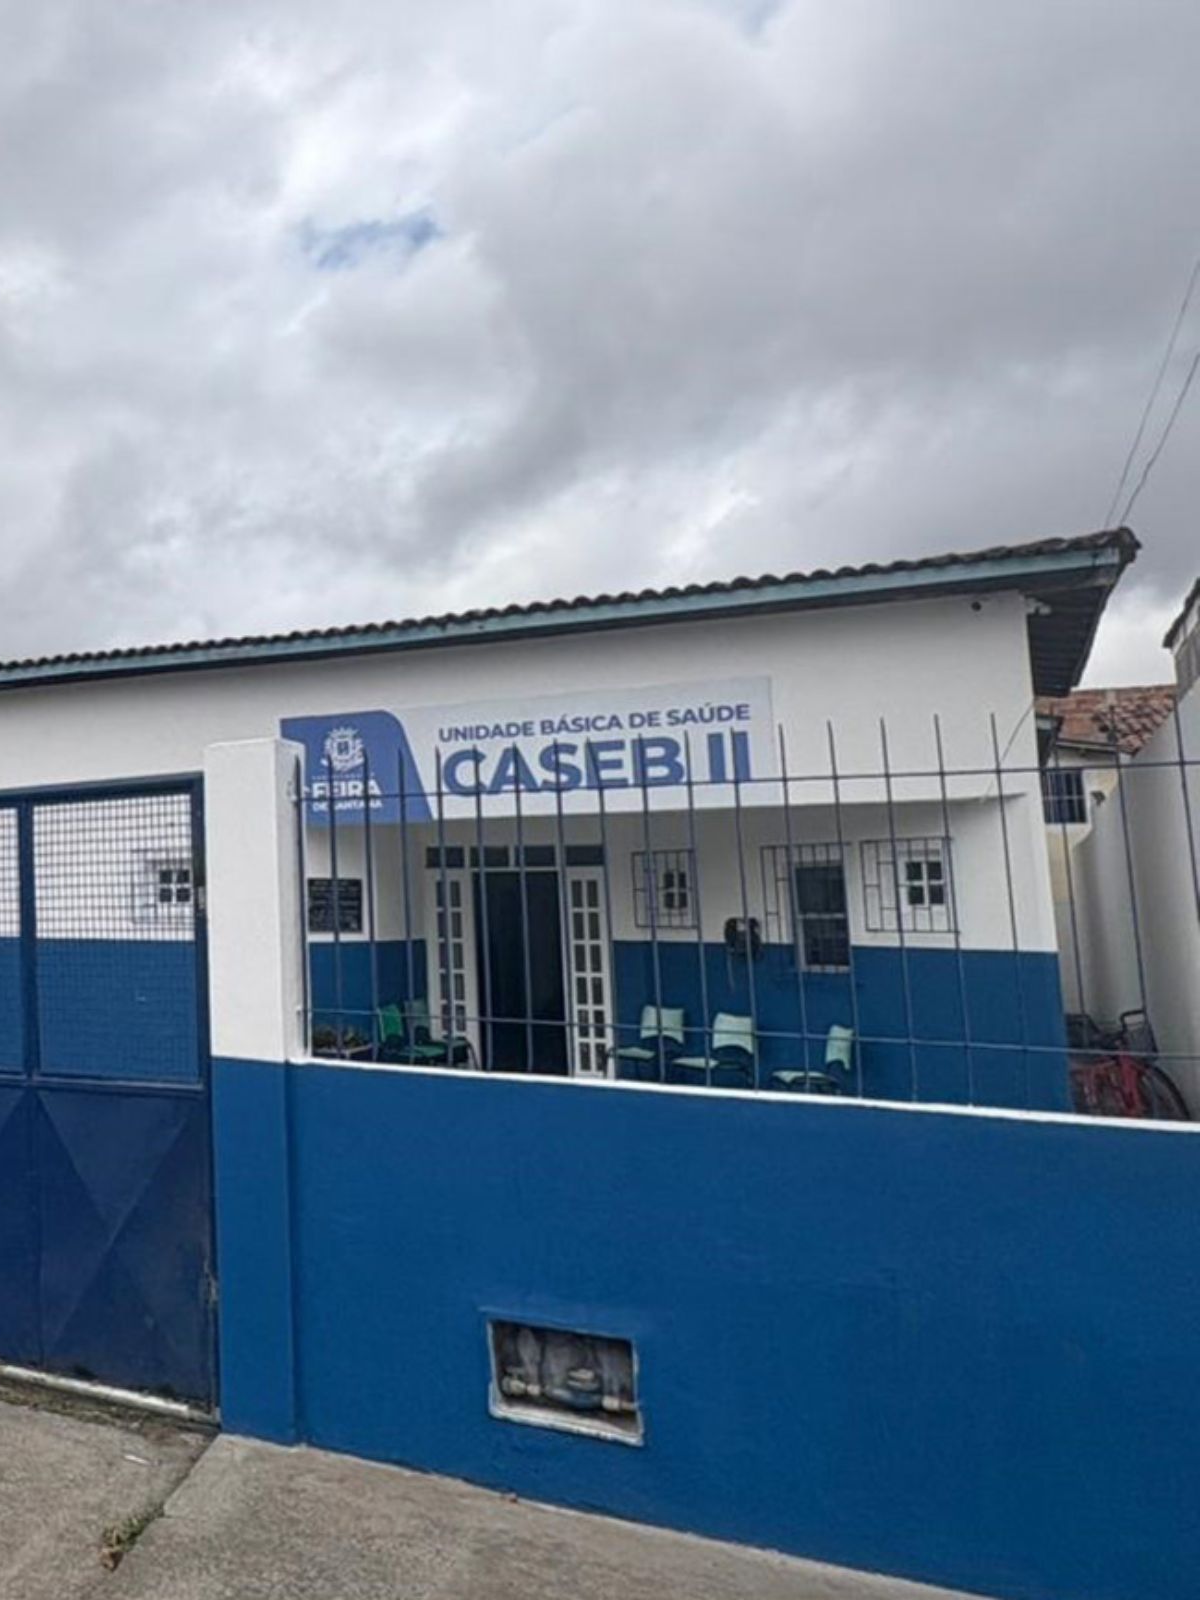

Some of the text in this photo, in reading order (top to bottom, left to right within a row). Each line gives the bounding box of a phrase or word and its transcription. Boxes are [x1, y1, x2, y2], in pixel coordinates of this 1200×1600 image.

[438, 703, 751, 742] UNIDADE BÁSICA DE SAÚDE
[443, 731, 751, 795] CASEB II
